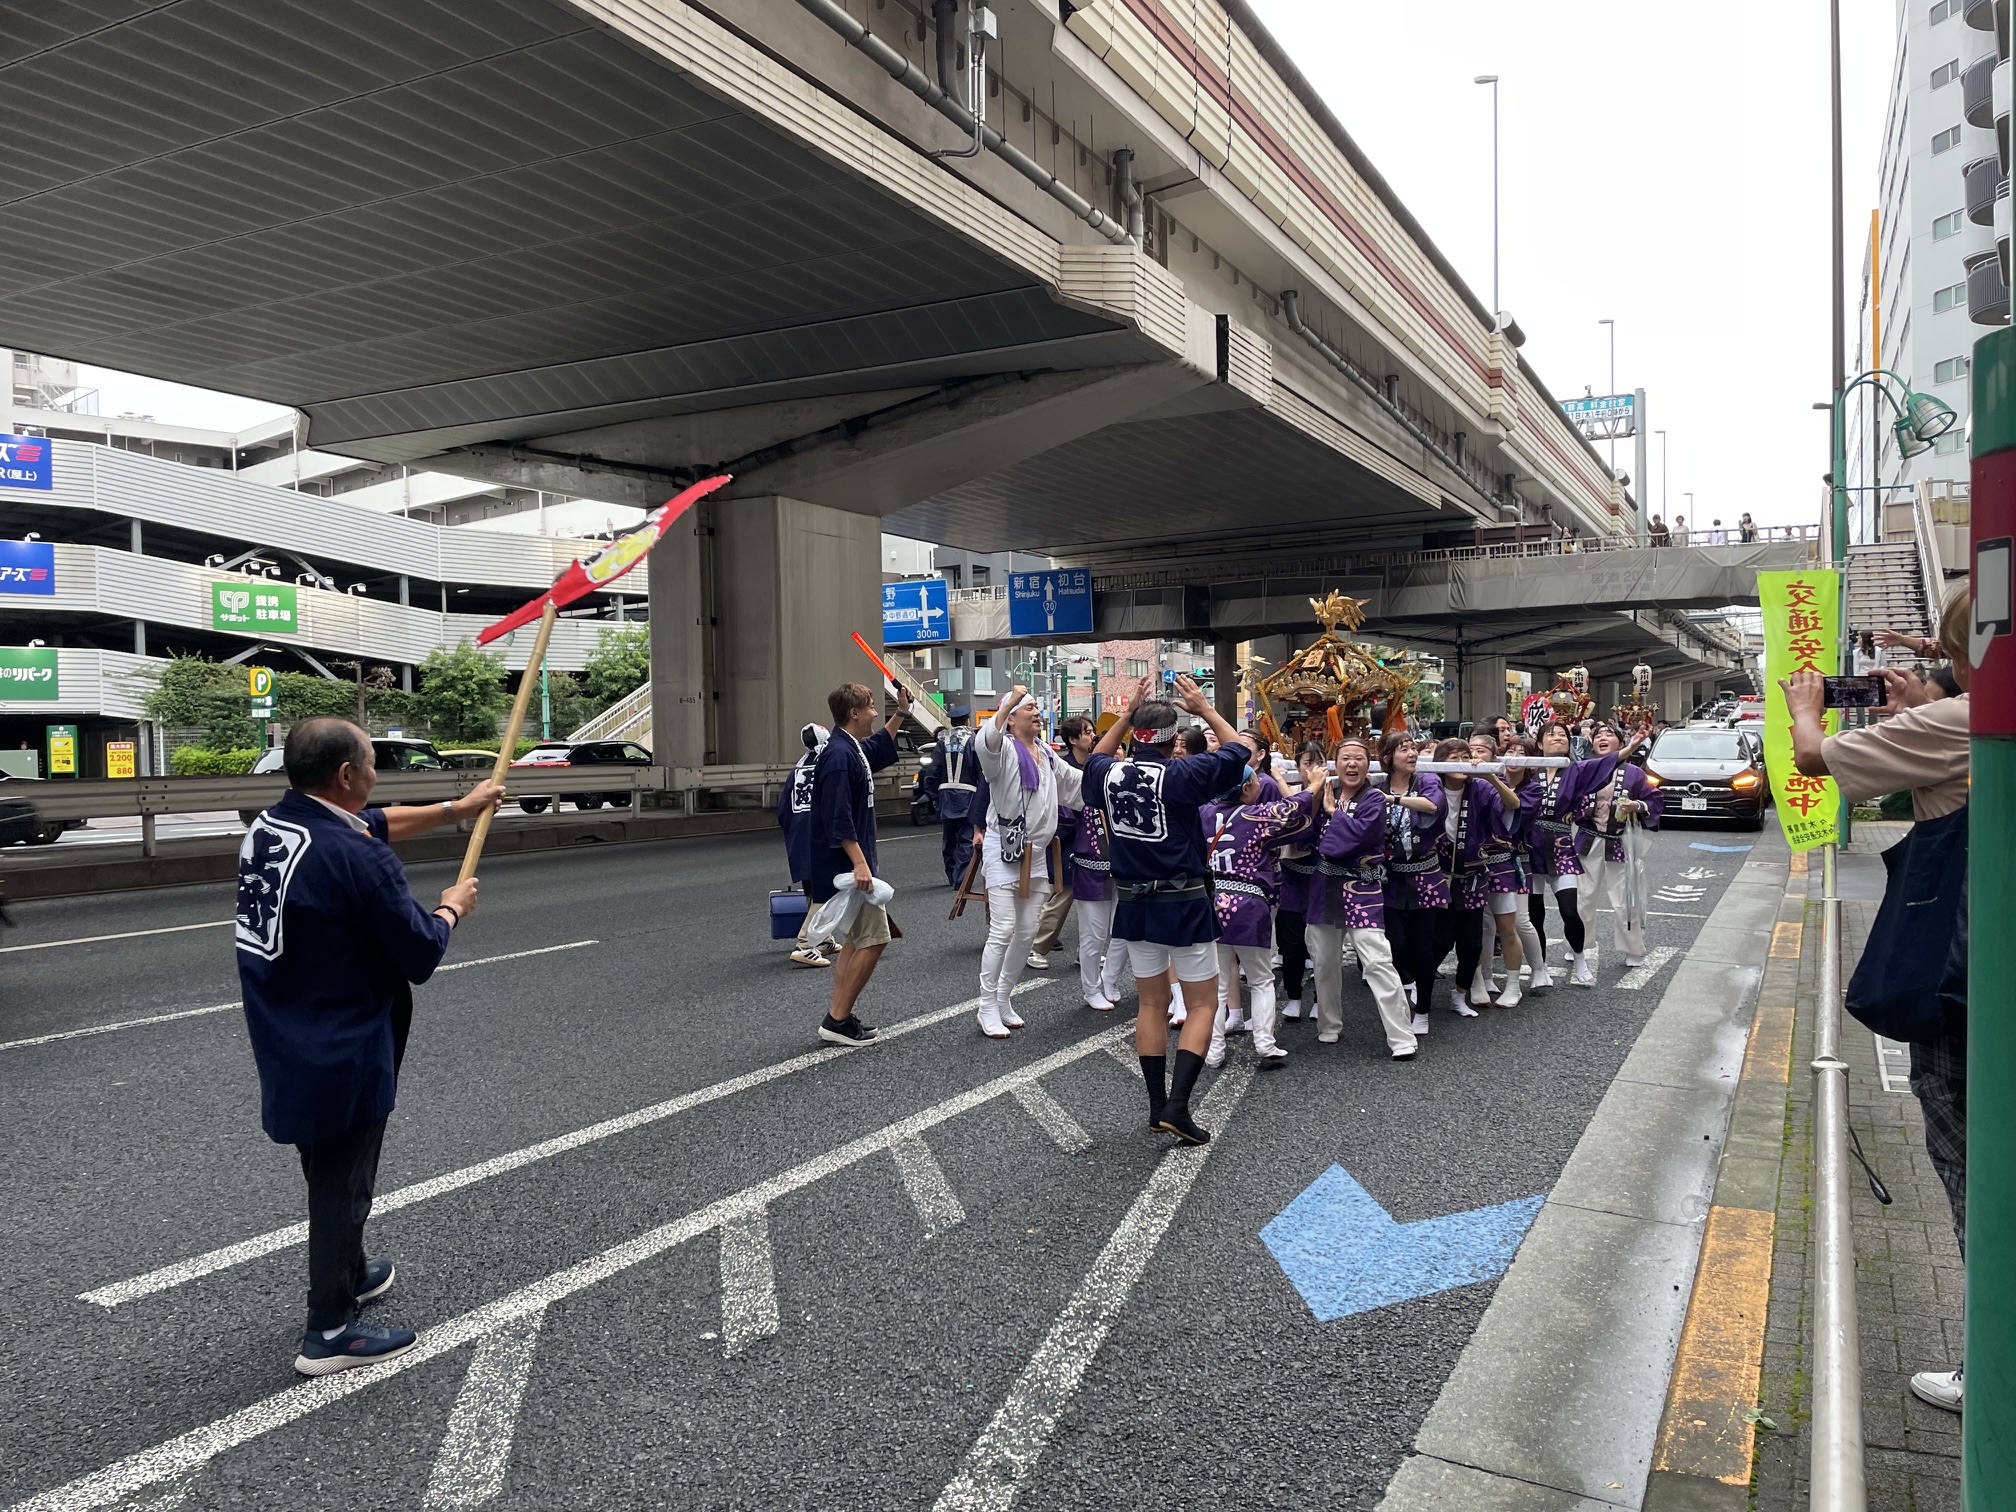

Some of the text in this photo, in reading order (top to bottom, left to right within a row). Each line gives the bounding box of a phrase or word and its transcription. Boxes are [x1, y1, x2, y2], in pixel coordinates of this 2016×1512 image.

[1013, 572, 1085, 590] 新宿 初台
[1015, 587, 1086, 599] Shinjuku Hatsudai
[255, 595, 279, 607] 提携
[1045, 602, 1055, 611] 20
[220, 613, 251, 623] サミット
[255, 609, 291, 621] 駐車場
[916, 629, 940, 639] 300m
[257, 673, 267, 691] P
